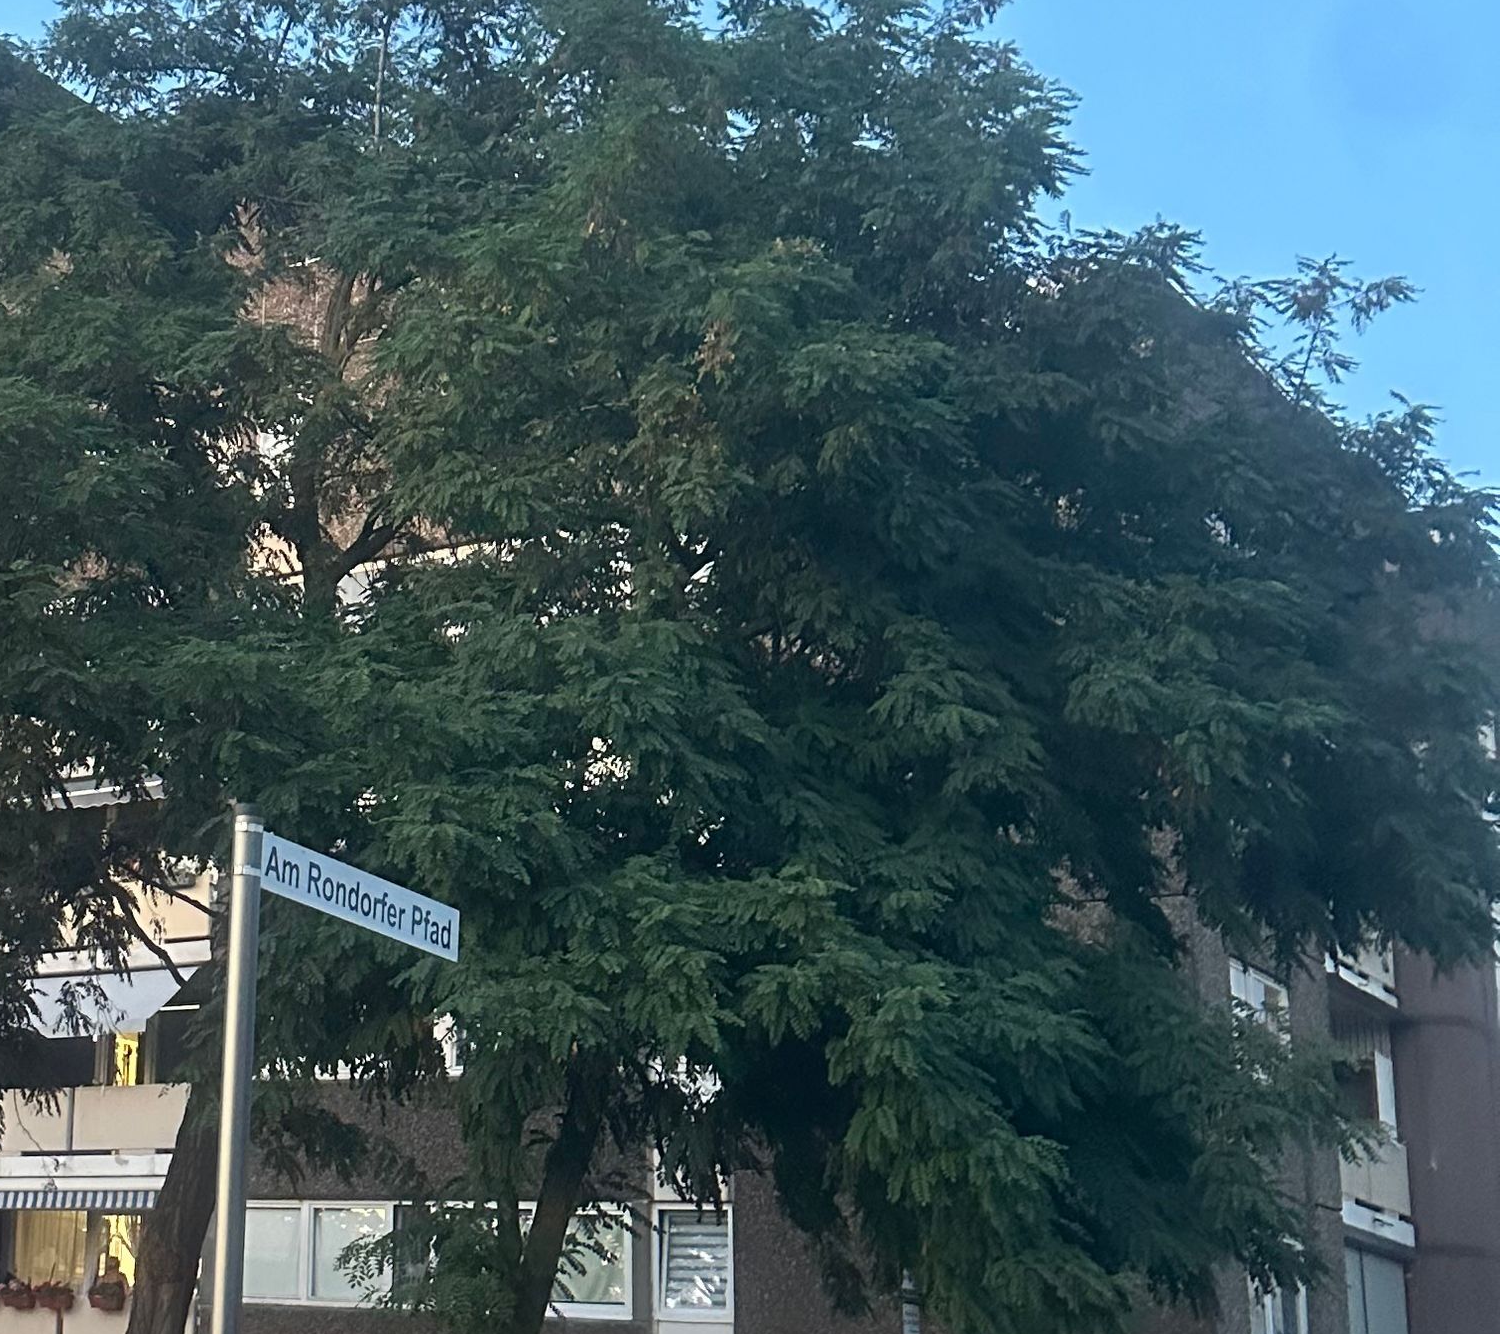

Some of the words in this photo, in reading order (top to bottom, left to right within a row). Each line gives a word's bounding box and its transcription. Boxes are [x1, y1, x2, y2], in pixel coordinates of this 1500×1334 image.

[264, 845, 300, 889] Am
[307, 861, 406, 931] Rondorfer
[411, 904, 452, 950] Pfad
